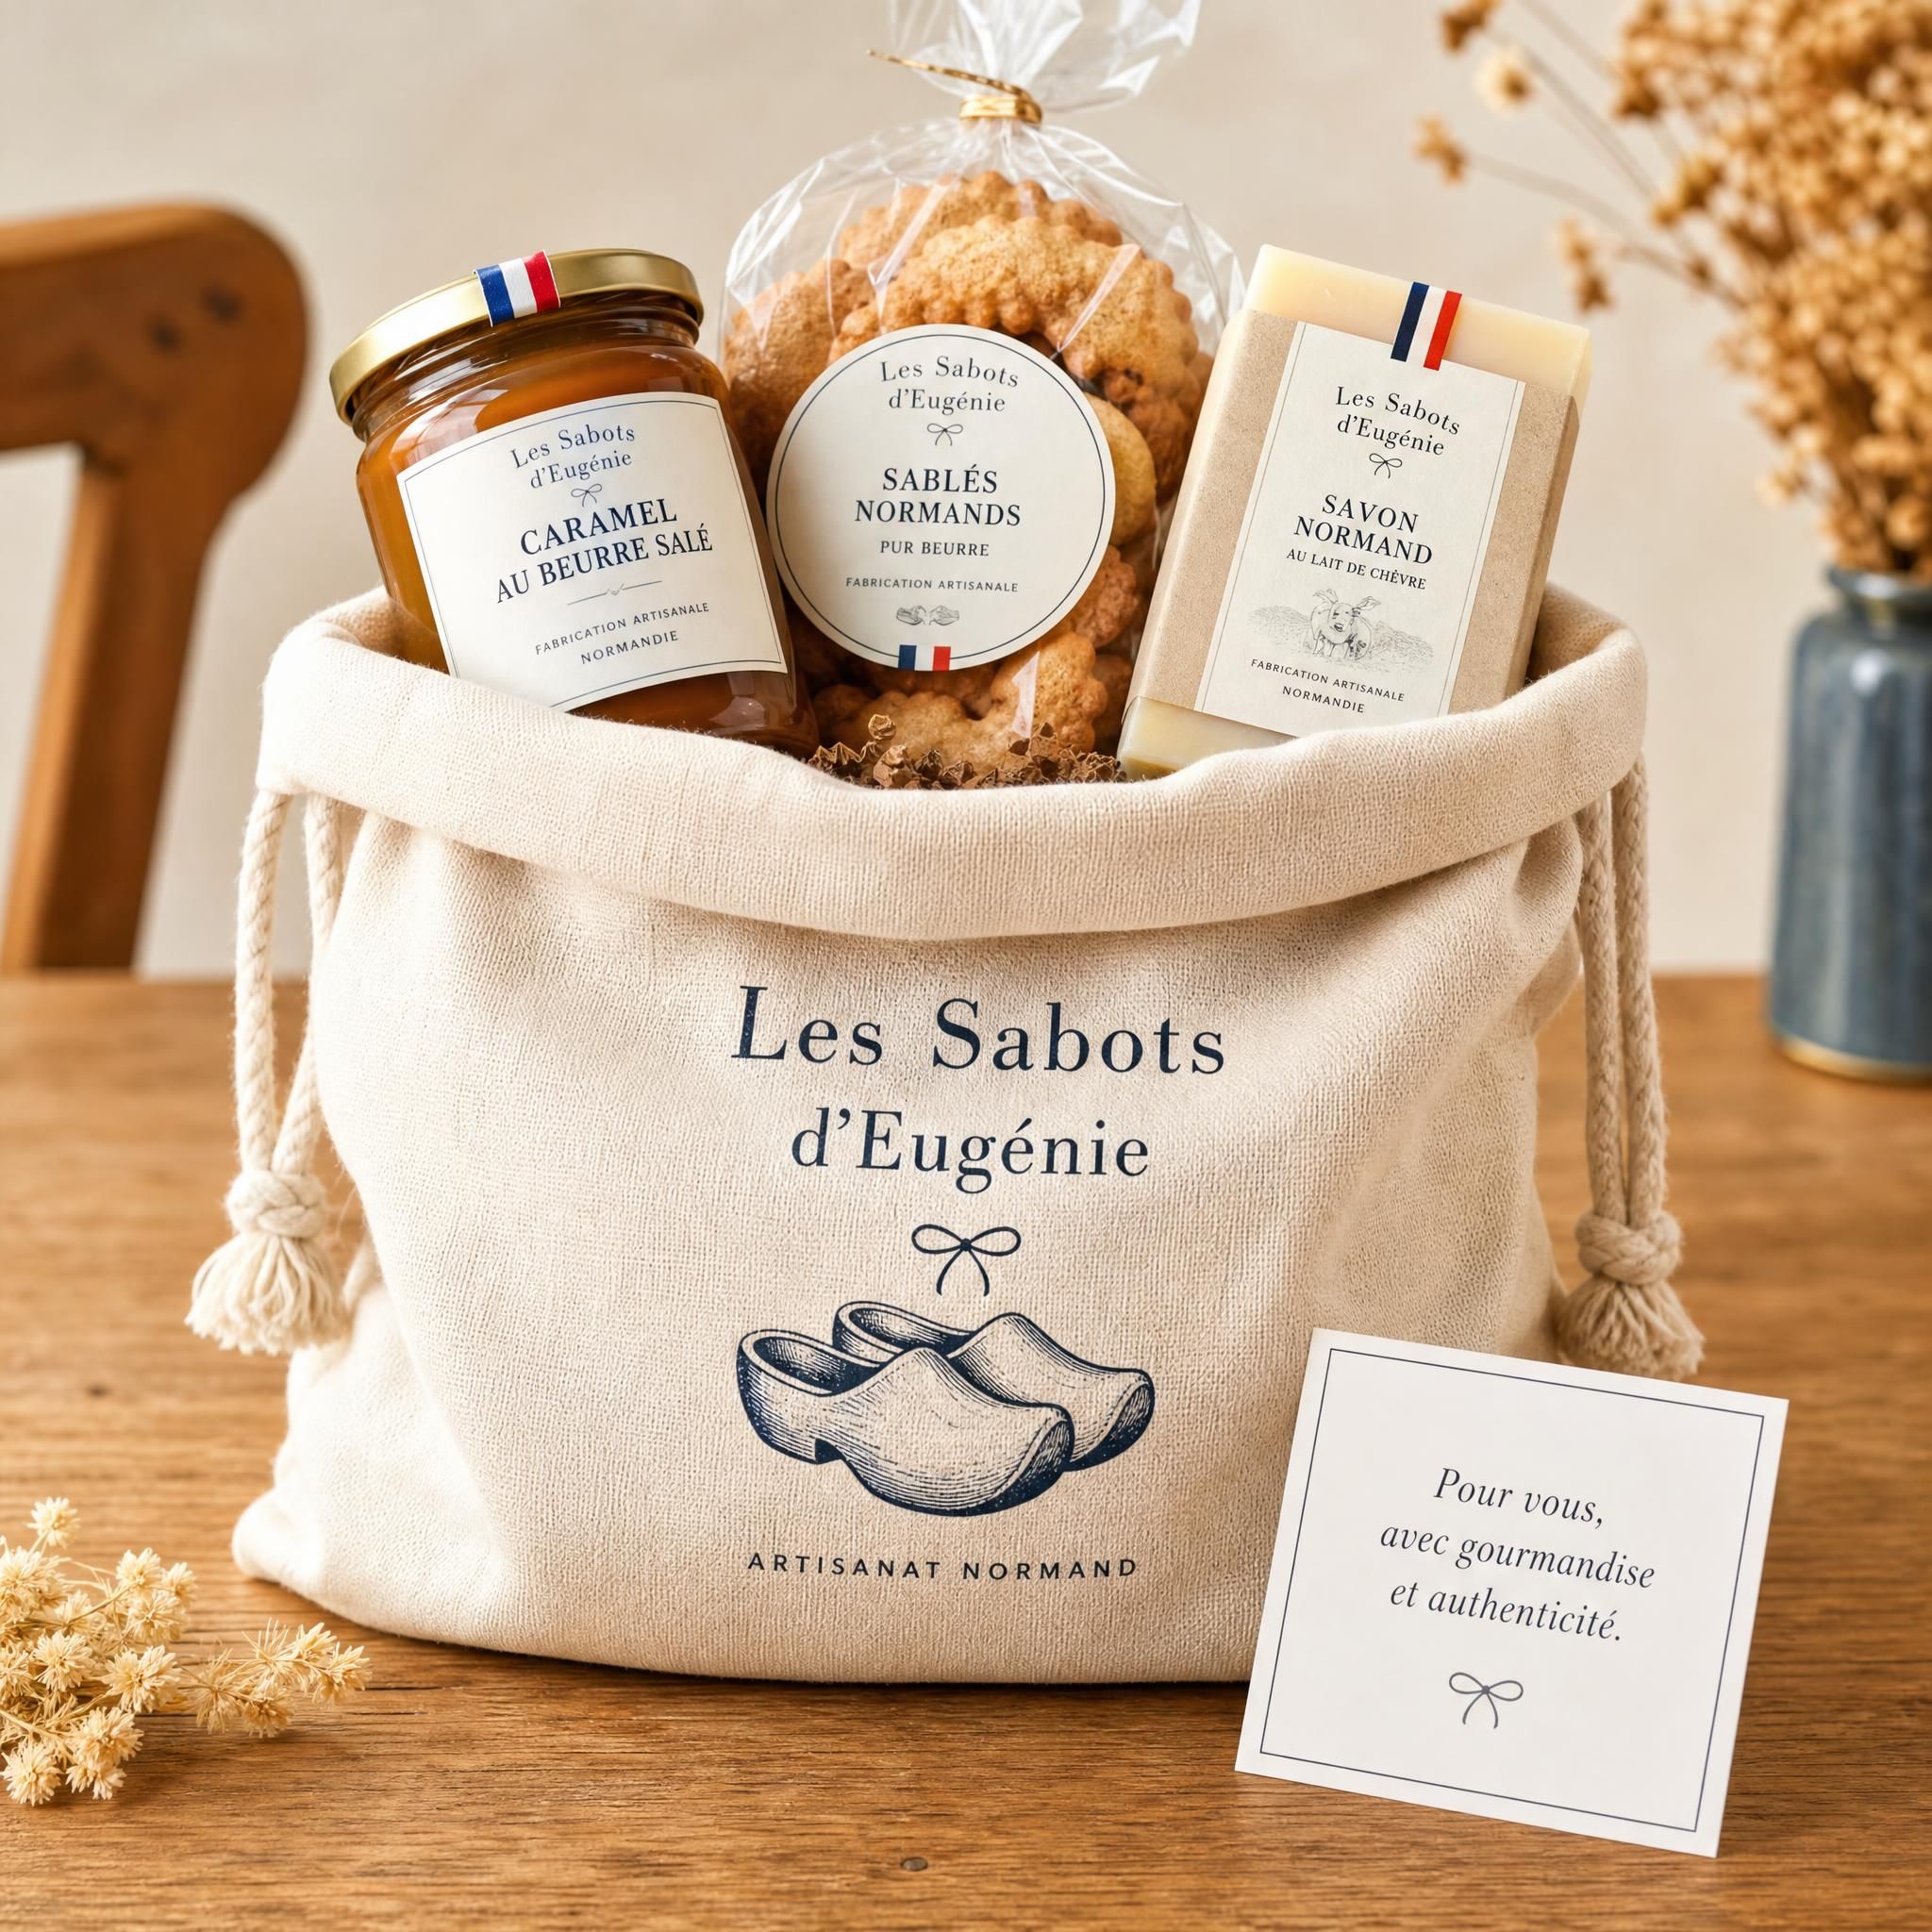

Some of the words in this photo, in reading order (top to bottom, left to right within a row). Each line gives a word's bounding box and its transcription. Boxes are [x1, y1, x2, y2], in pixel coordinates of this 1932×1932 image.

[882, 362, 922, 381] Les
[936, 357, 1017, 387] Sabots
[890, 389, 1005, 415] d’Eugénie
[1336, 387, 1374, 408] Les
[1386, 393, 1459, 434] Sabots
[511, 444, 550, 468] Les
[558, 425, 634, 449] Sabots
[1338, 413, 1443, 455] d’Eugénie
[530, 451, 631, 488] d’Eugénie
[883, 464, 996, 493] SABLÉS
[521, 499, 676, 555] CARAMEL
[855, 500, 1020, 525] NORMANDS
[1323, 495, 1418, 533] SAVON
[881, 541, 913, 554] PUR
[922, 542, 989, 556] BEURRE
[1293, 516, 1432, 565] NORMAND
[498, 570, 528, 603] AU
[538, 538, 649, 586] BEURRE
[656, 523, 712, 556] SALÉ
[1287, 549, 1307, 561] AU
[1311, 554, 1343, 570] LAIT
[1347, 562, 1366, 575] DE
[845, 577, 931, 588] FABRICATION
[939, 581, 1017, 591] ARTISANALE
[535, 619, 626, 655] FABRICATION
[634, 603, 708, 625] ARTISANALE
[581, 629, 678, 664] NORMANDIE
[1252, 659, 1328, 683] FABRICATION
[1333, 679, 1404, 701] ARTISANALE
[1283, 684, 1366, 713] NORMANDIE
[731, 983, 883, 1066] Les
[933, 997, 1224, 1074] Sabots
[792, 1108, 1148, 1194] d’Eugénie
[1434, 1468, 1513, 1507] Pour
[1525, 1493, 1602, 1528] vous,
[748, 1553, 940, 1578] ARTISANAT
[963, 1557, 1136, 1580] NORMAND
[1381, 1527, 1449, 1555] avec
[1456, 1540, 1654, 1588] gourmandise
[1391, 1583, 1418, 1607] et
[1428, 1588, 1620, 1641] authenticité.
